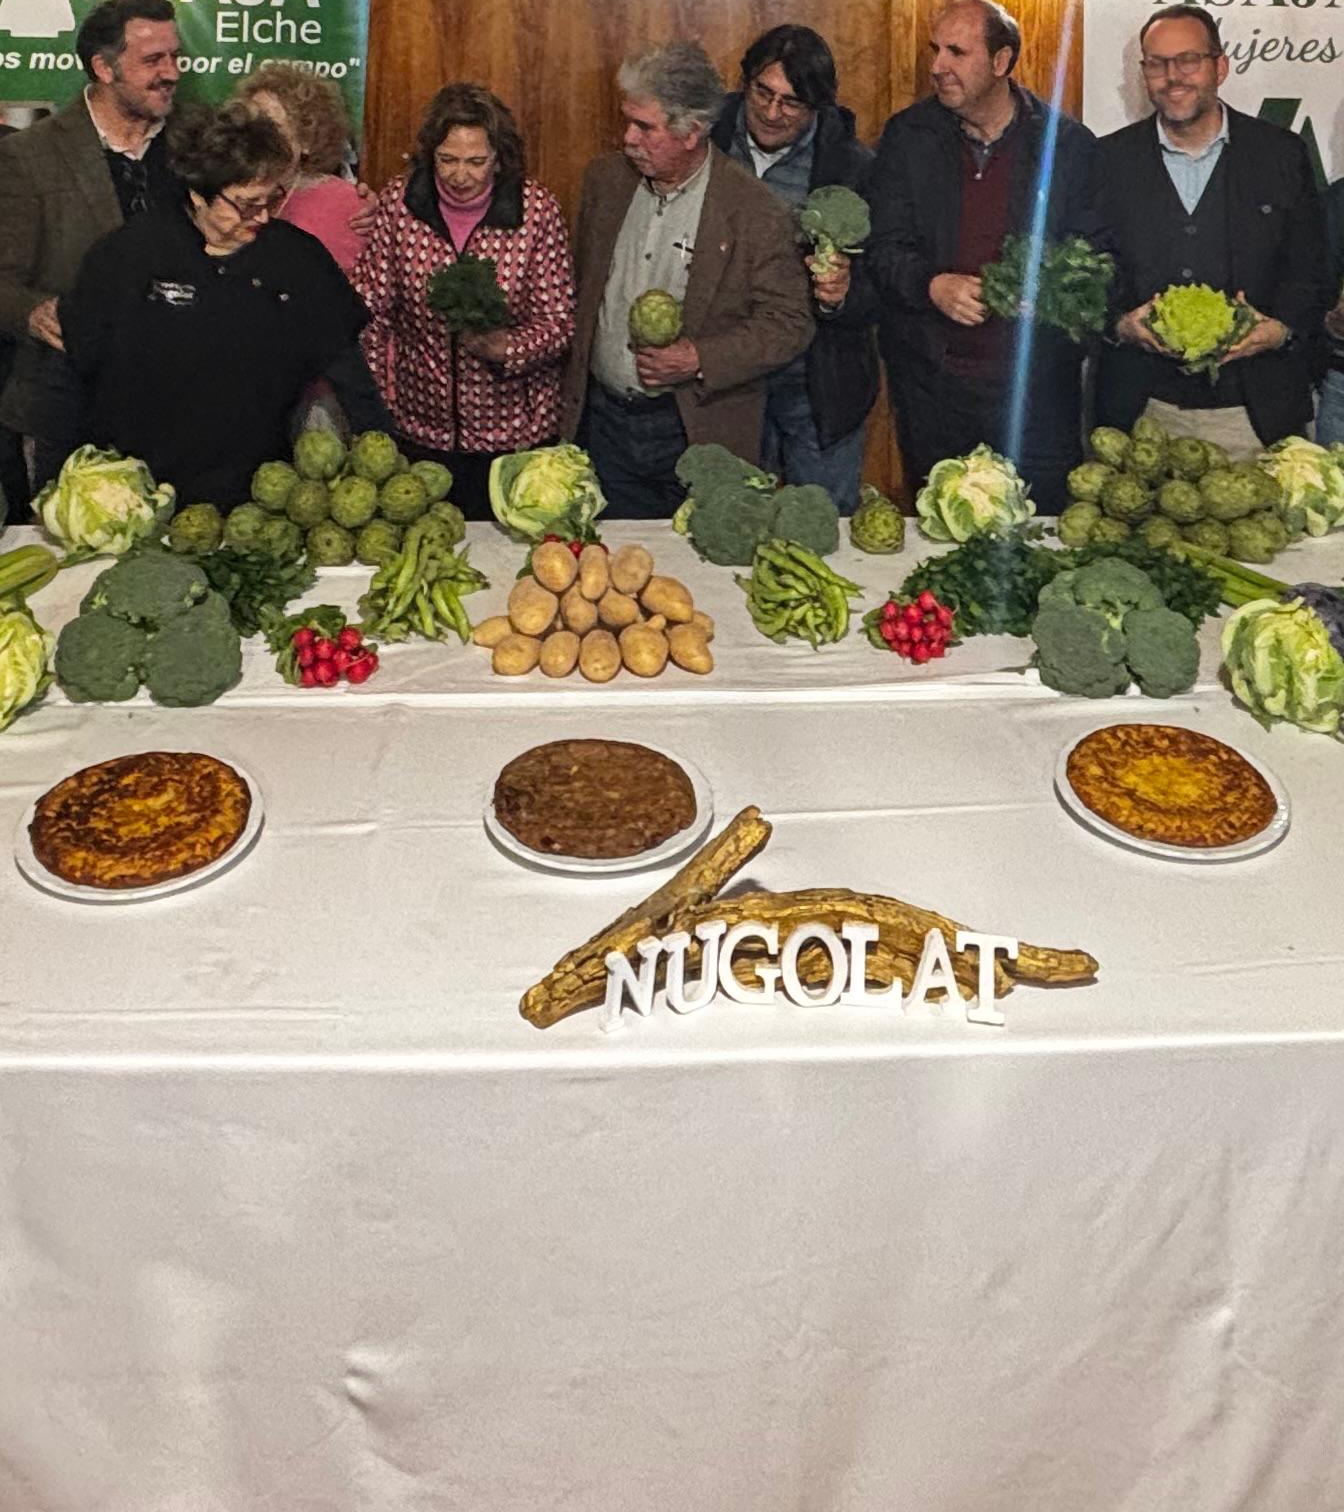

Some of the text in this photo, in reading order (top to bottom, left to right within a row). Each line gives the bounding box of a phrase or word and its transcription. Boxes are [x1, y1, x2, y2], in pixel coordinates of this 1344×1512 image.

[216, 11, 322, 44] Elche
[1216, 16, 1344, 75] ujeres
[227, 53, 253, 74] el
[599, 919, 1019, 1033] NUGOLAT
